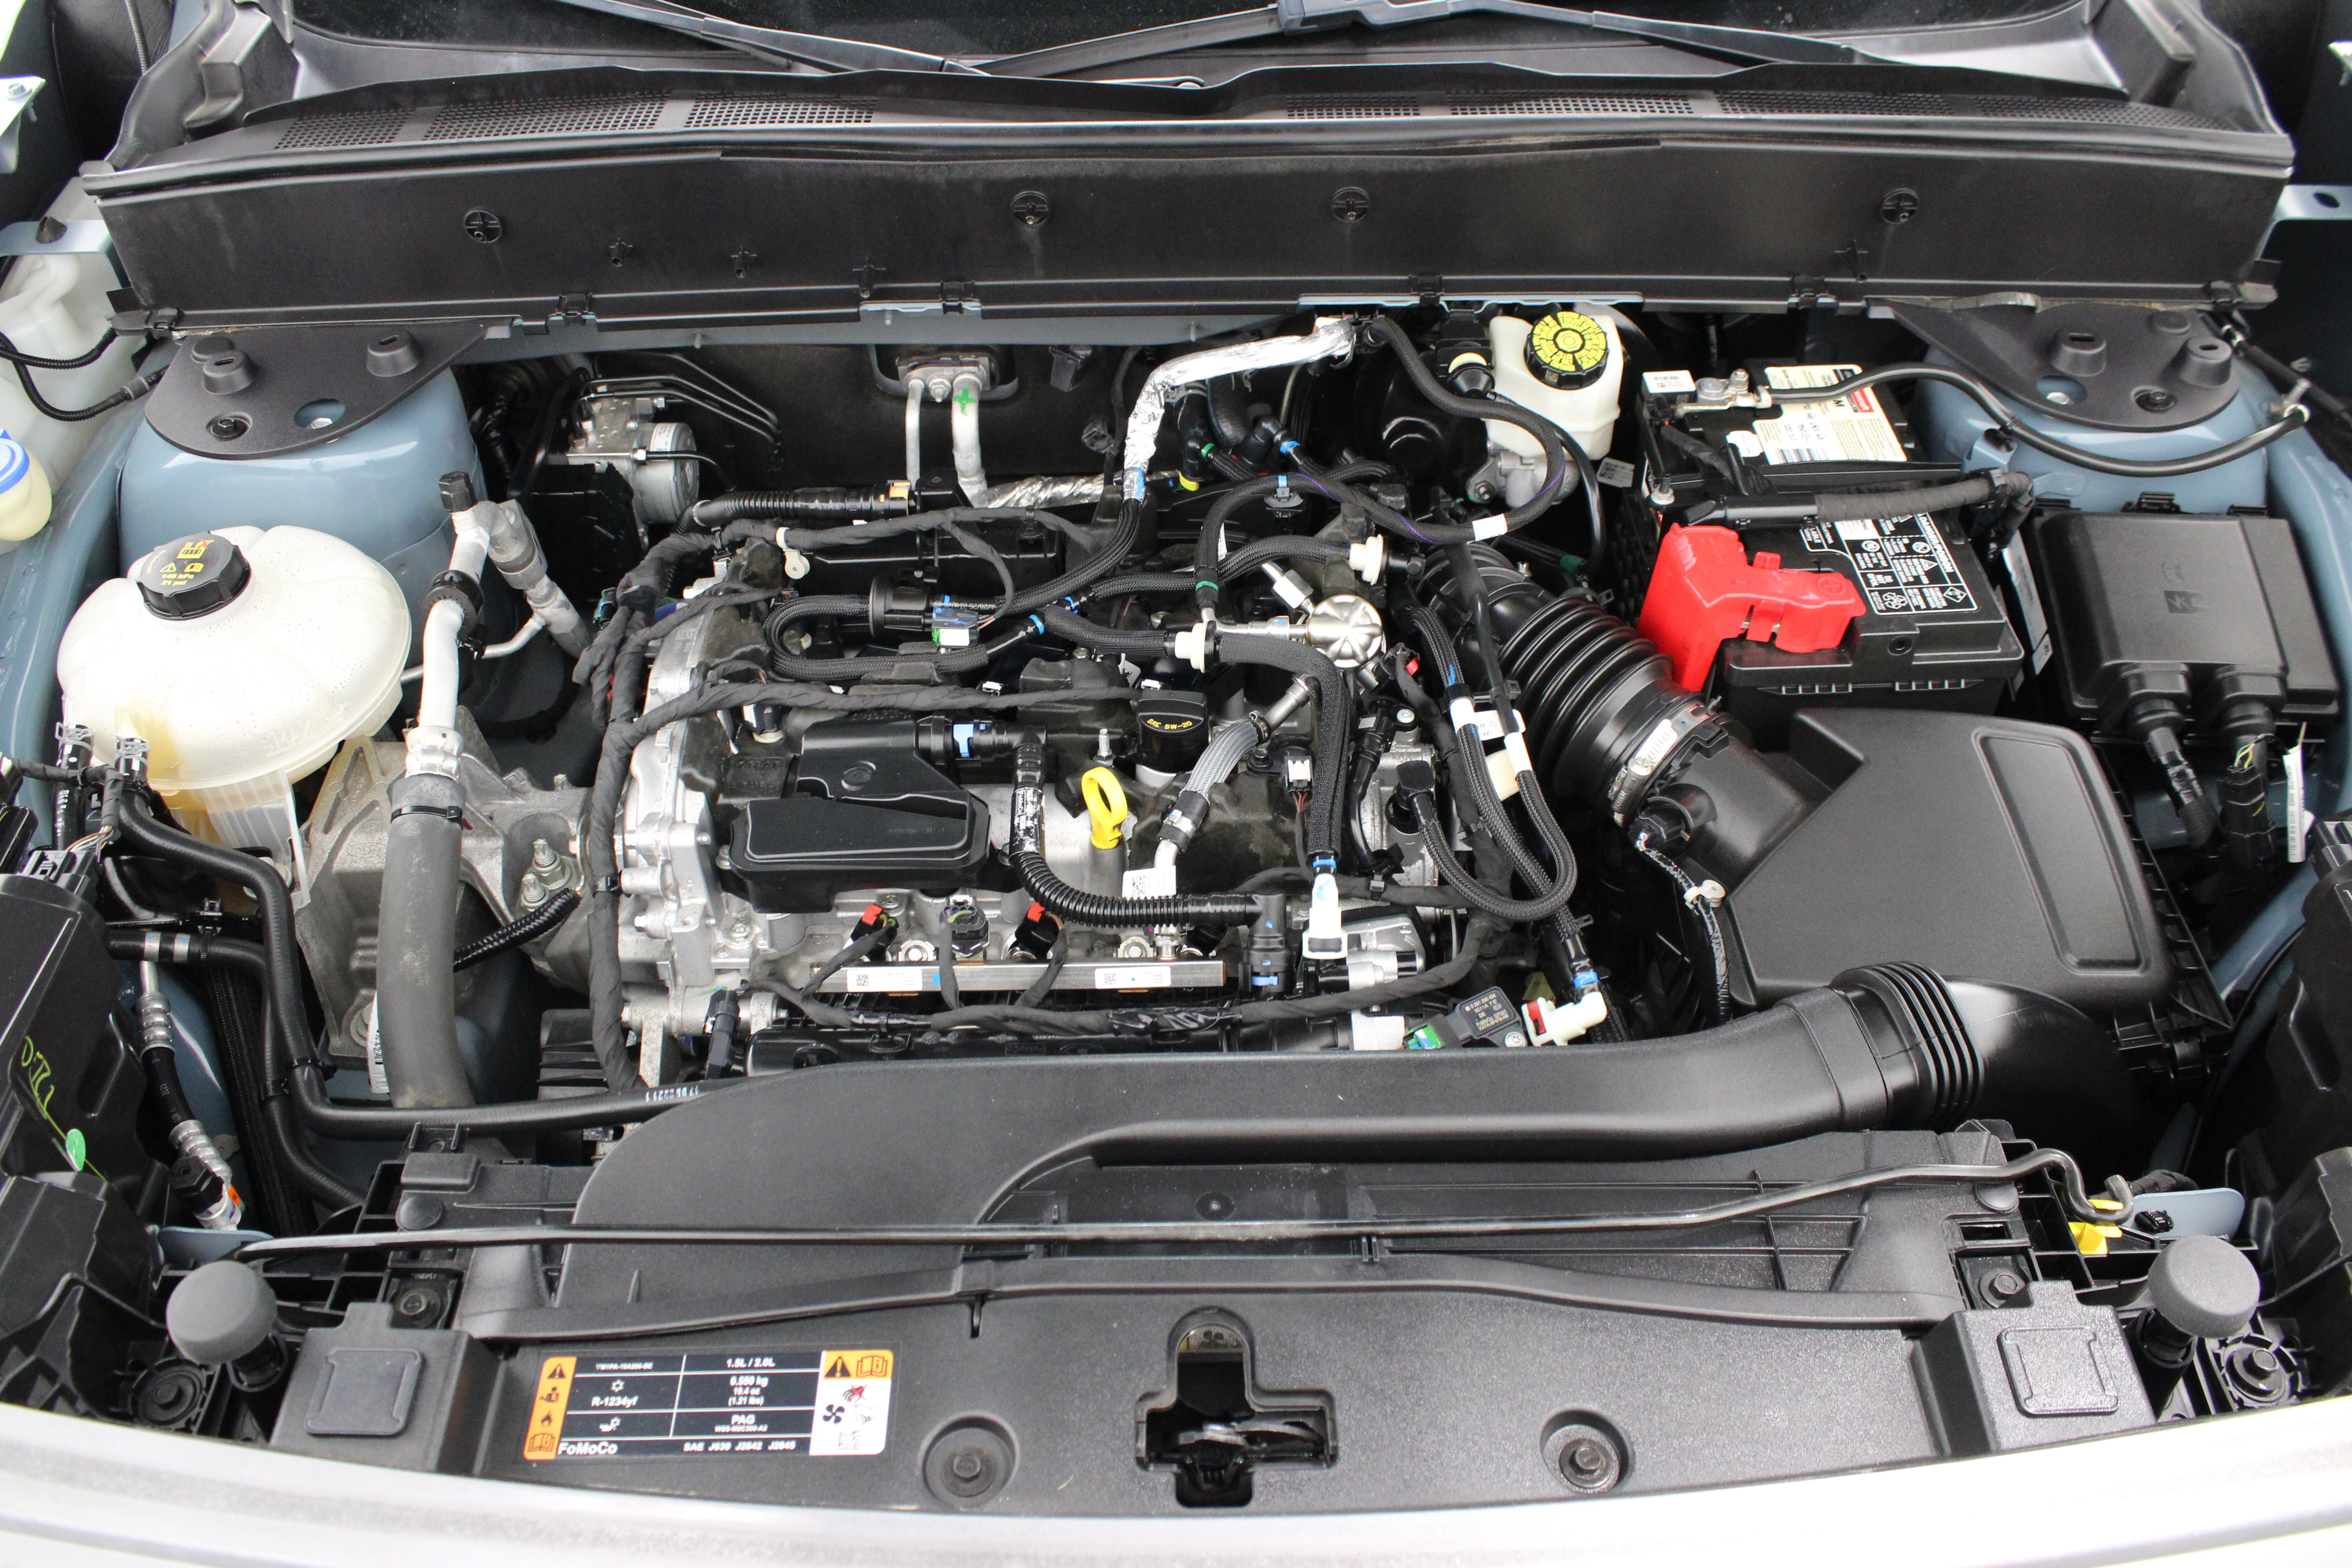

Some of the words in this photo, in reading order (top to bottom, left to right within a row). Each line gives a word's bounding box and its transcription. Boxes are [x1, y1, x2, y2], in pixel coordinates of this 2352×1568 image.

[1916, 516, 1956, 572] DANGER/POISON
[1875, 575, 1886, 584] NOT
[1147, 718, 1162, 728] SAE
[1164, 721, 1193, 729] 5W-20
[726, 1357, 747, 1368] 1.5L
[754, 1357, 775, 1368] 2.0L
[730, 1375, 755, 1386] 0.550
[756, 1375, 769, 1388] kg
[733, 1386, 749, 1395] 19.4
[750, 1387, 761, 1395] oz
[591, 1395, 639, 1408] R-1234yf
[728, 1396, 747, 1407] (1.21
[748, 1395, 764, 1406] lbs)
[731, 1413, 756, 1425] PAG
[557, 1441, 618, 1455] FoMoCo
[683, 1442, 705, 1452] SAE
[708, 1441, 732, 1452] J639
[735, 1441, 763, 1451] J2842
